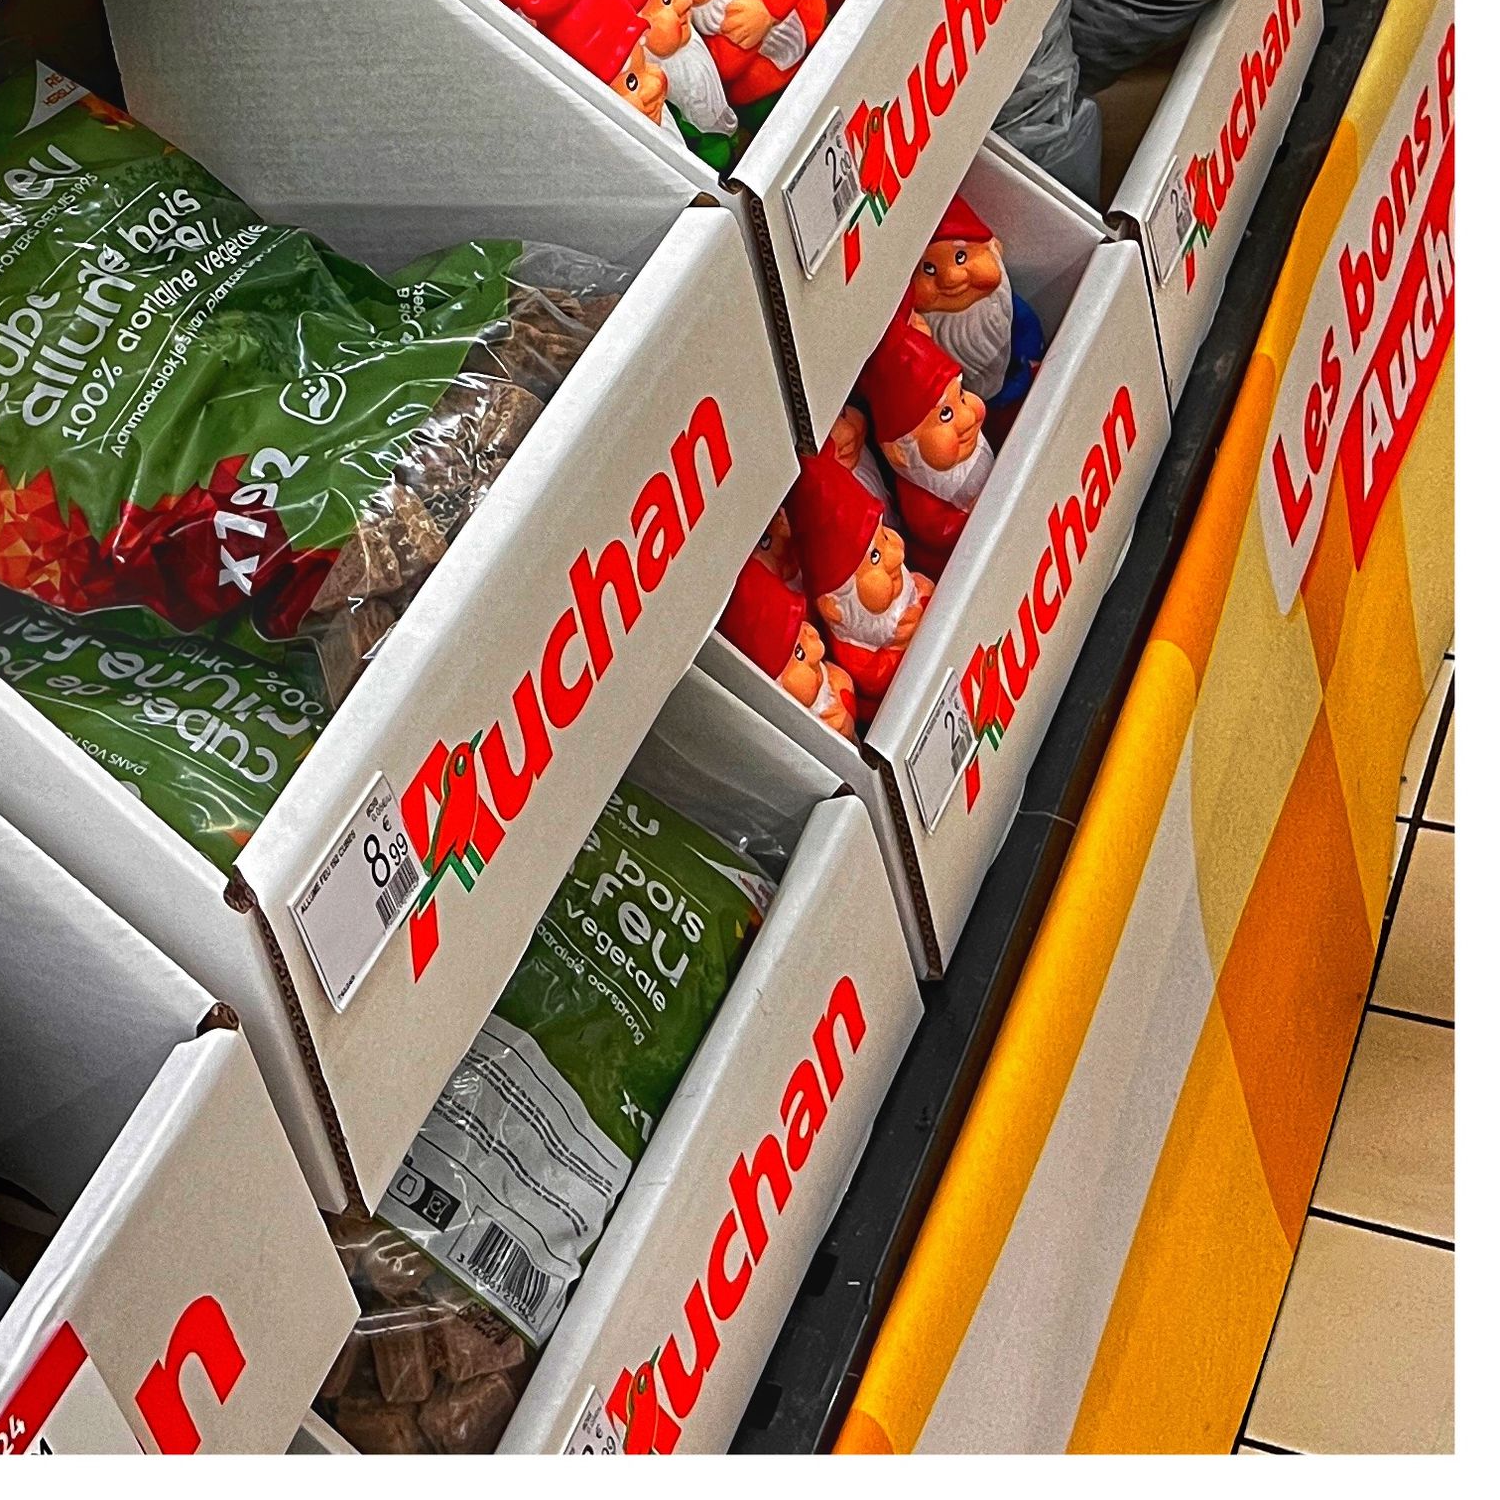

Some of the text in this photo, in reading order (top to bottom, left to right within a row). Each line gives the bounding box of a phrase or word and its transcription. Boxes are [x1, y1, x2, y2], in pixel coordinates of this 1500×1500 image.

[33, 191, 77, 230] DEPUIS
[69, 171, 99, 198] 1995
[115, 188, 203, 255] bois
[61, 357, 124, 443] 100%
[116, 265, 199, 354] d'origine
[1273, 325, 1343, 548] Les
[1339, 85, 1432, 355] bons
[1362, 217, 1455, 501] Auch
[110, 329, 193, 461] Aanmaakblokjes
[185, 309, 208, 333] van
[214, 446, 311, 597] x192
[964, 385, 1137, 815] Auchan
[45, 674, 114, 698] de
[253, 669, 326, 718] 00%
[399, 395, 732, 983] Auchan
[78, 736, 149, 778] DANS VOS
[115, 690, 279, 784] cubes
[300, 885, 323, 916] ALLUME
[318, 866, 332, 887] FEU
[338, 828, 358, 858] CUBES
[615, 848, 706, 944] bois
[587, 973, 646, 1047] oorsprong
[620, 1088, 654, 1144] x1
[604, 975, 867, 1455] Auchan
